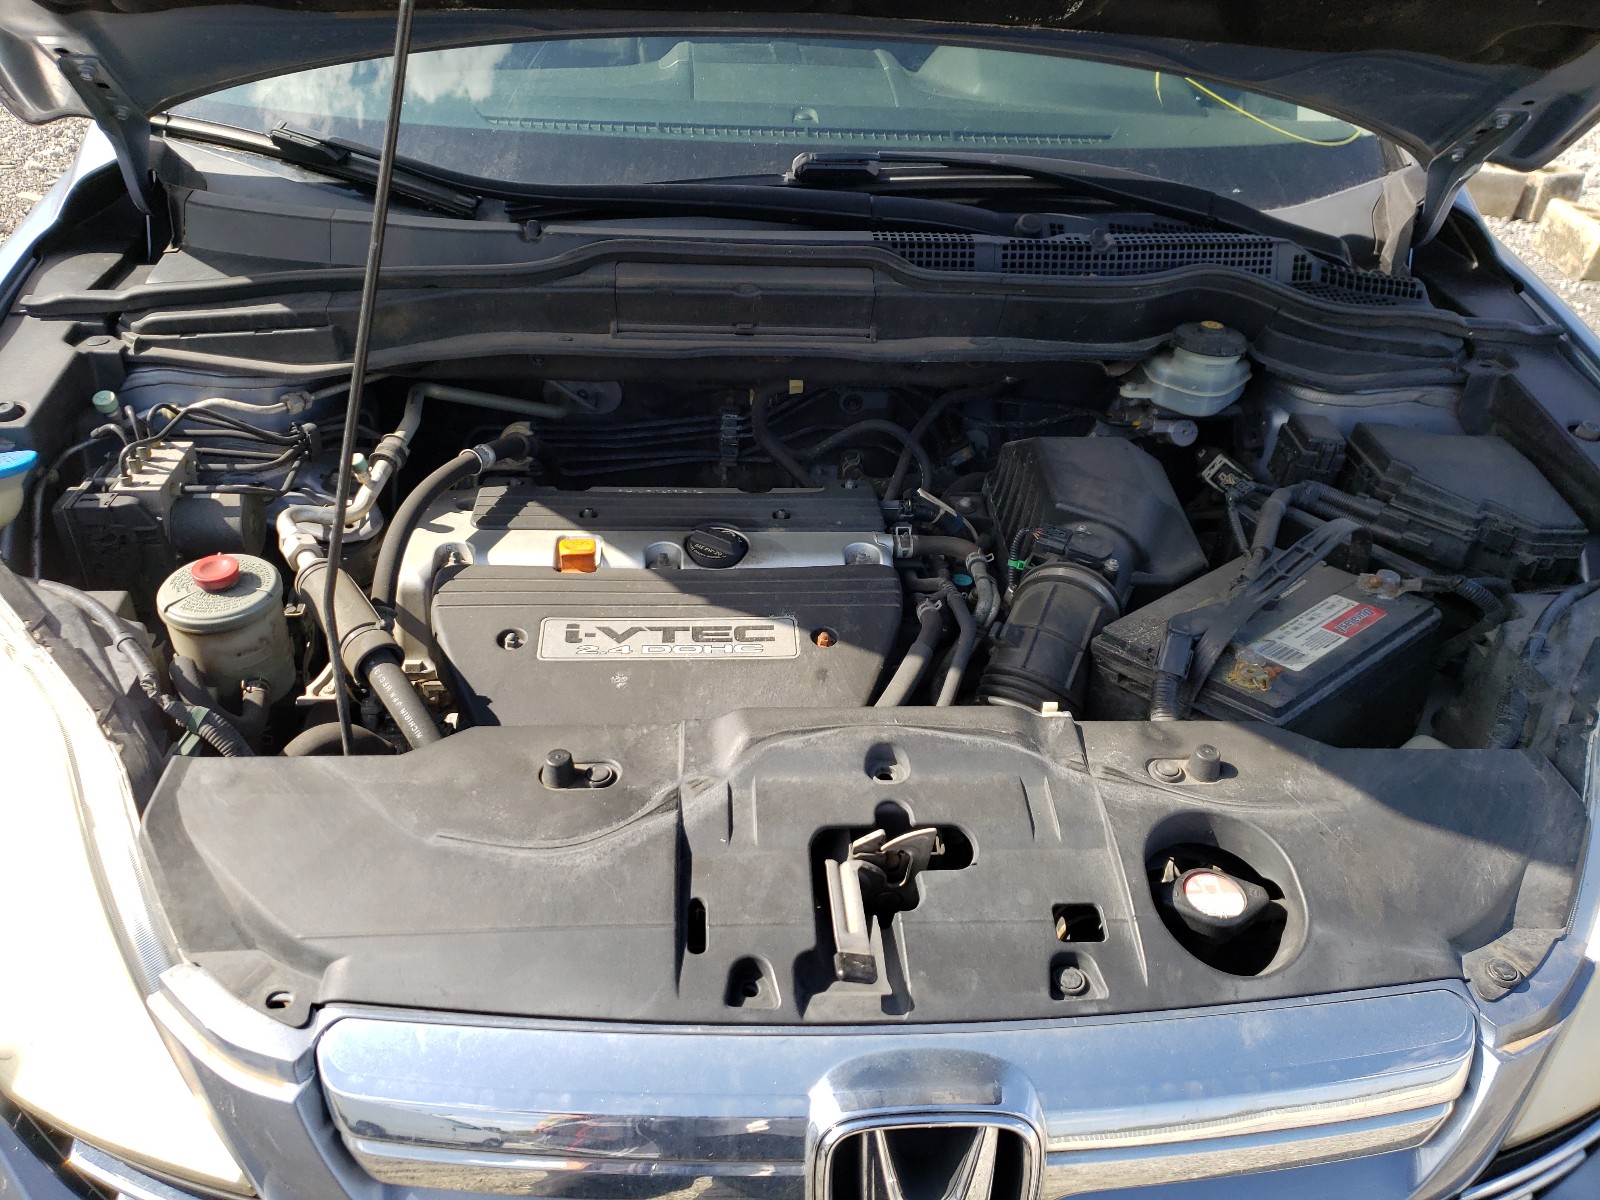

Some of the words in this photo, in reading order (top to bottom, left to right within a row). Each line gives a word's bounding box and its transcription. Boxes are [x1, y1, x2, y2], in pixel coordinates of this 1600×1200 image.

[751, 301, 817, 313] NUMBER
[1333, 607, 1376, 634] Duralast
[564, 623, 776, 644] i-VTEC
[576, 644, 634, 655] 2.4
[641, 644, 764, 655] DOHC
[389, 691, 403, 706] JPN
[399, 707, 423, 739] NICHIRIN
